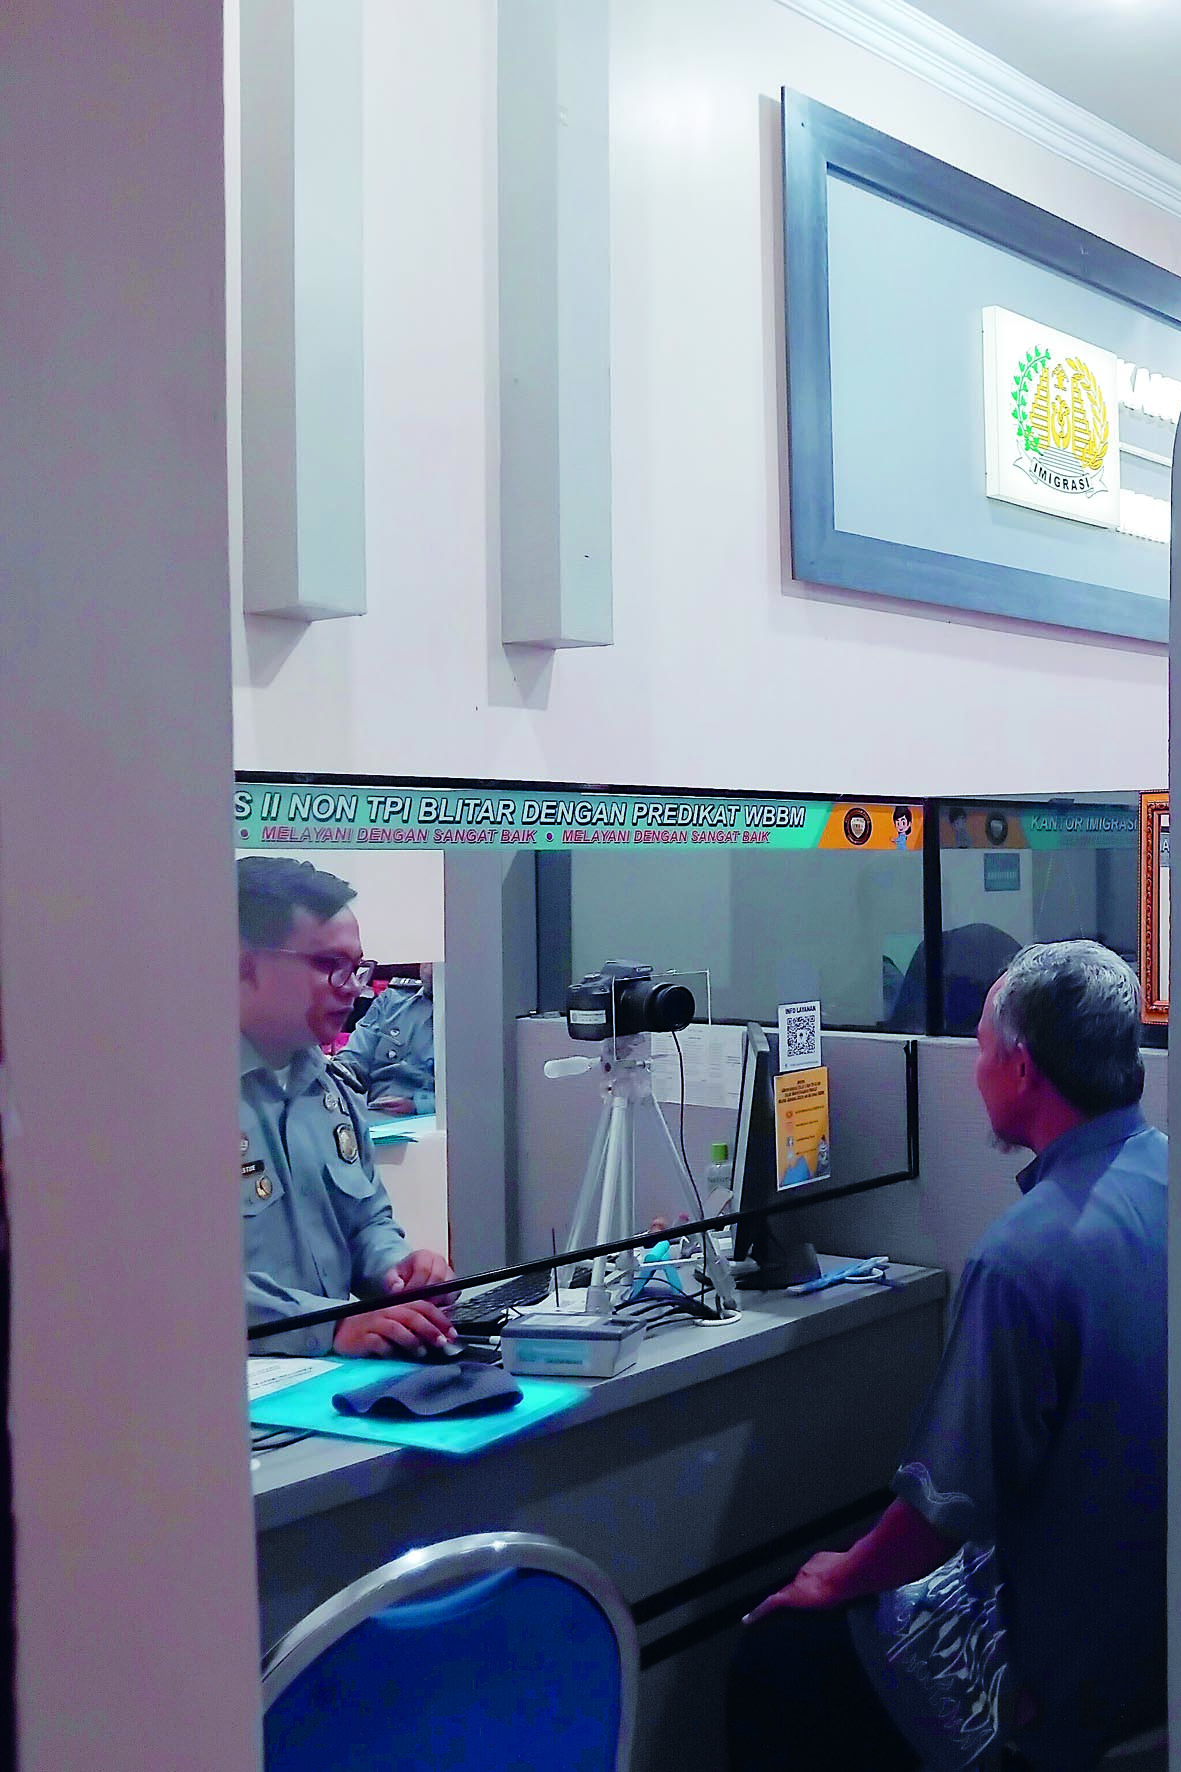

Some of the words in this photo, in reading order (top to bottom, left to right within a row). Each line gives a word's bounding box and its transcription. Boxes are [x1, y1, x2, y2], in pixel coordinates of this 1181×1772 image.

[1033, 462, 1090, 490] IMIGRASI
[288, 793, 358, 822] NON
[367, 796, 413, 823] TPI
[418, 798, 515, 825] BLITAR
[521, 800, 627, 825] DENGAN
[632, 803, 741, 827] PREDIKAT
[743, 806, 807, 828] WBBM
[1031, 813, 1083, 832] KANTOR
[261, 826, 350, 842] MELAYANI
[356, 827, 428, 843] DENGAN
[433, 828, 498, 844] SANGAT
[500, 829, 537, 844] BAIK
[561, 829, 631, 844] MELAYANI
[633, 830, 688, 844] DENGAN
[690, 831, 741, 844] SANGAT
[742, 831, 771, 844] BAIK
